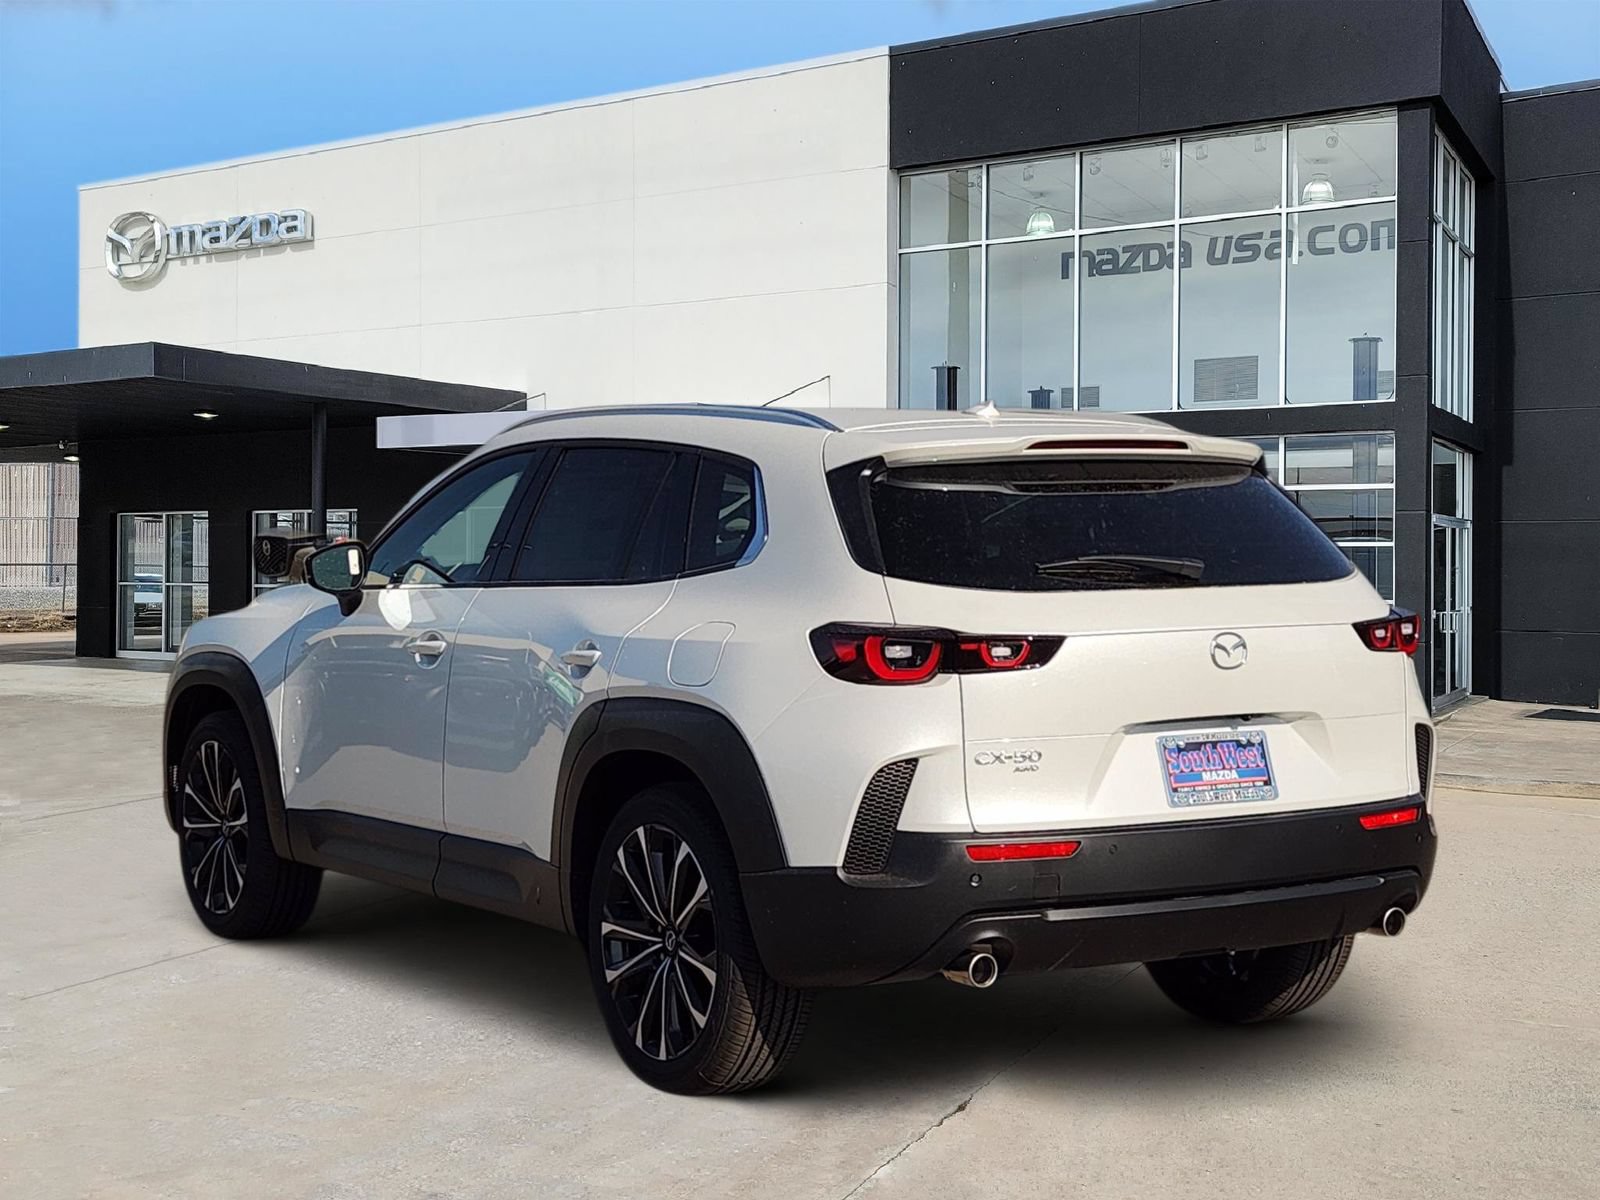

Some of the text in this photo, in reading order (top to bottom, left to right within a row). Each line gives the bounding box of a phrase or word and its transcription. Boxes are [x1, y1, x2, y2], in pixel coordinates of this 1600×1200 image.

[166, 208, 313, 257] mazda
[1061, 240, 1192, 280] mazda
[974, 750, 1042, 765] CX-50
[1202, 770, 1239, 782] MAZDA
